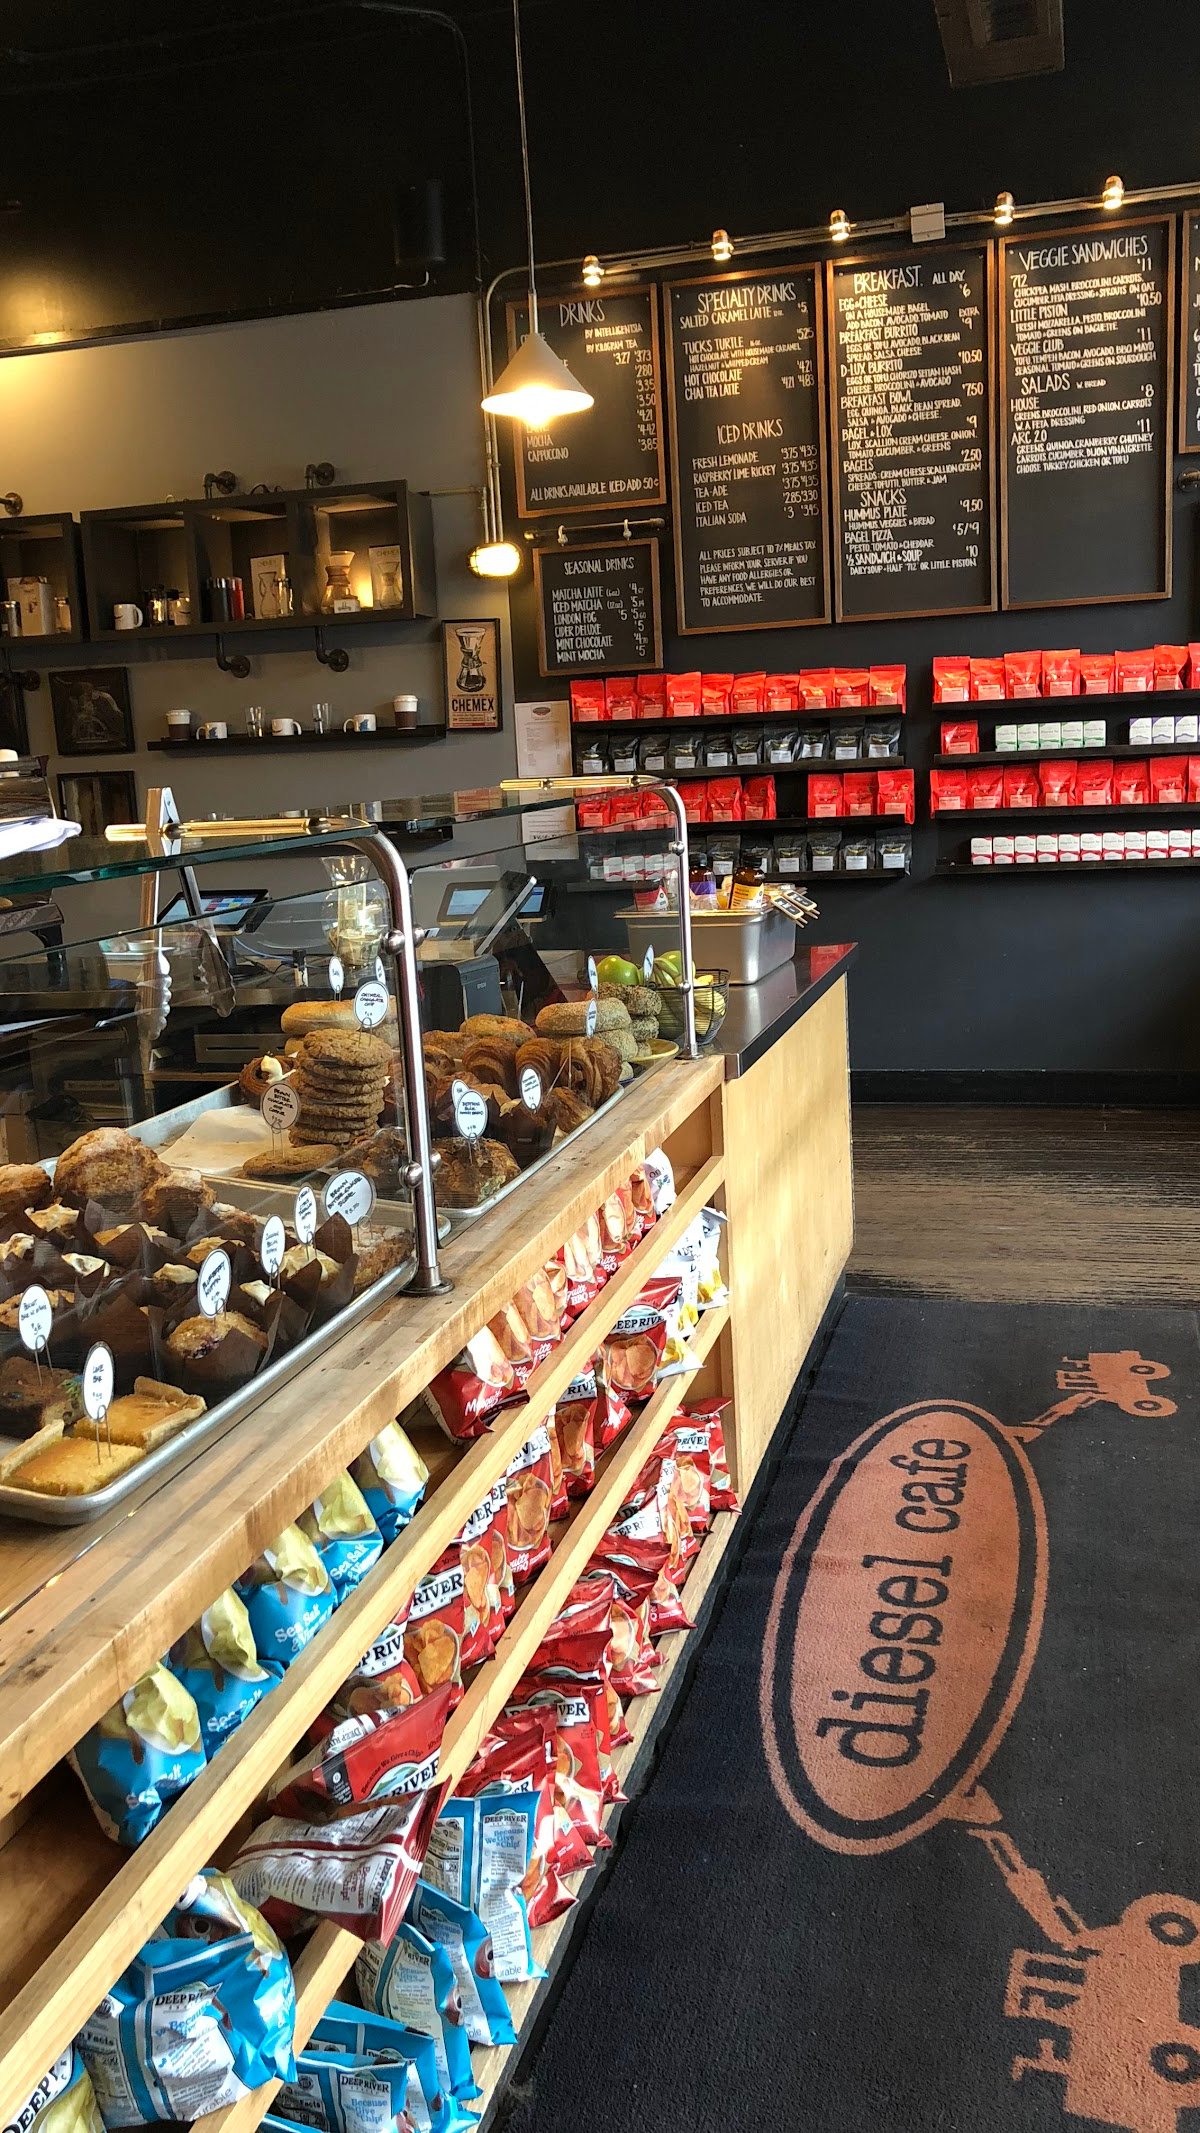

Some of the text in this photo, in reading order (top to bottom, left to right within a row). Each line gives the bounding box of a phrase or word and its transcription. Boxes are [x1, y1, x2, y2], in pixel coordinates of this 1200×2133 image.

[1019, 235, 1148, 271] VEGGIE SANDWICHES
[932, 273, 946, 285] ALL
[698, 283, 796, 313] SPECIALTY DRINKS
[560, 300, 605, 327] DRINKS
[908, 303, 930, 313] BAGEL
[1011, 308, 1037, 323] LITTLE
[1039, 303, 1068, 320] PISTON
[680, 306, 771, 329] SALTED CARAMEL LATTE
[840, 324, 918, 344] BREAKFAST BURRITO
[626, 340, 637, 349] TEA
[714, 336, 743, 349] TURTLE
[1011, 339, 1064, 357] VEGGIE CLUB
[841, 363, 865, 377] D-LUX
[868, 359, 903, 374] BURRITO
[684, 369, 742, 387] HOT CHOCOLATE
[1021, 373, 1070, 396] SALADS
[706, 385, 718, 398] TEA
[841, 390, 913, 409] BREAKFAST BOWL
[1011, 397, 1039, 412] HOUSE
[718, 419, 783, 444] ICED DRINKS
[842, 425, 893, 441] BAGEL LOX
[1011, 431, 1032, 446] ARC
[692, 451, 759, 470] FRESH LEMONADE
[844, 459, 874, 473] BAGELS
[694, 464, 776, 484] RASPBERRY LIME RICKEY
[860, 488, 907, 507] SNACKS
[696, 500, 728, 513] ICED TEA
[844, 507, 880, 522] HUMMUS
[884, 505, 907, 519] PLATE
[696, 512, 746, 527] ITALIAN SODA
[845, 529, 893, 544] BAGEL PIZZA
[700, 551, 711, 561] ALL
[713, 548, 735, 559] PRICES
[738, 545, 764, 557] SUBJECT
[855, 551, 896, 564] SANDWICH
[902, 550, 923, 563] SOUP
[564, 557, 634, 575] SEASONAL DRINKS
[700, 562, 721, 574] PLEASE
[764, 556, 788, 567] SERVER
[701, 574, 717, 585] HAVE
[719, 572, 731, 583] ANY
[732, 571, 748, 581] FOOD
[784, 579, 798, 588] OUR
[800, 577, 816, 586] BEST
[552, 586, 603, 601] MATCHA LATTE
[553, 599, 603, 613] ICED MATCHA
[554, 612, 597, 626] LONDON FOG
[555, 624, 601, 638] CIDER DELUXE
[556, 635, 613, 651] MINT CHOCOLATE
[557, 649, 605, 663] MINT MOCHA
[452, 698, 494, 712] CHEMEX
[413, 1573, 463, 1606] RIVER
[817, 1436, 972, 1770] diesel cafe
[373, 1635, 401, 1660] RIV
[558, 1702, 587, 1716] VER
[485, 1813, 526, 1823] DEEP RIVER
[155, 1994, 186, 2006] DEEP
[342, 2076, 389, 2092] DEEP RIVER
